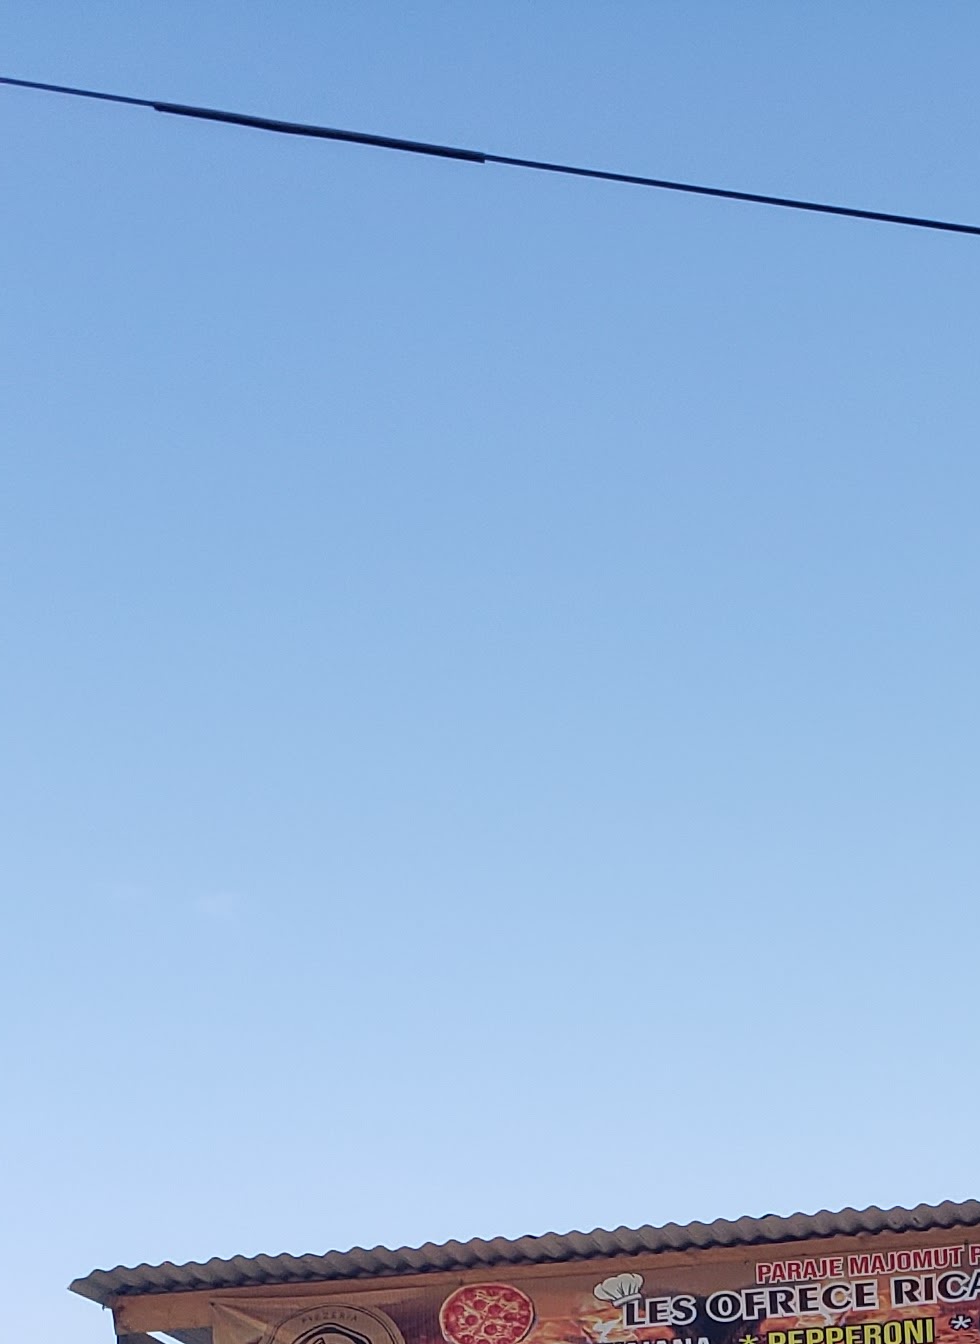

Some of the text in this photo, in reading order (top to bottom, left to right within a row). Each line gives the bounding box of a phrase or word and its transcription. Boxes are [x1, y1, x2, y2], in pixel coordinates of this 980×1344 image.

[756, 1257, 844, 1285] PARAJE
[848, 1245, 965, 1278] MAJOMUT
[622, 1294, 697, 1329] LES
[705, 1278, 879, 1322] OFRECE
